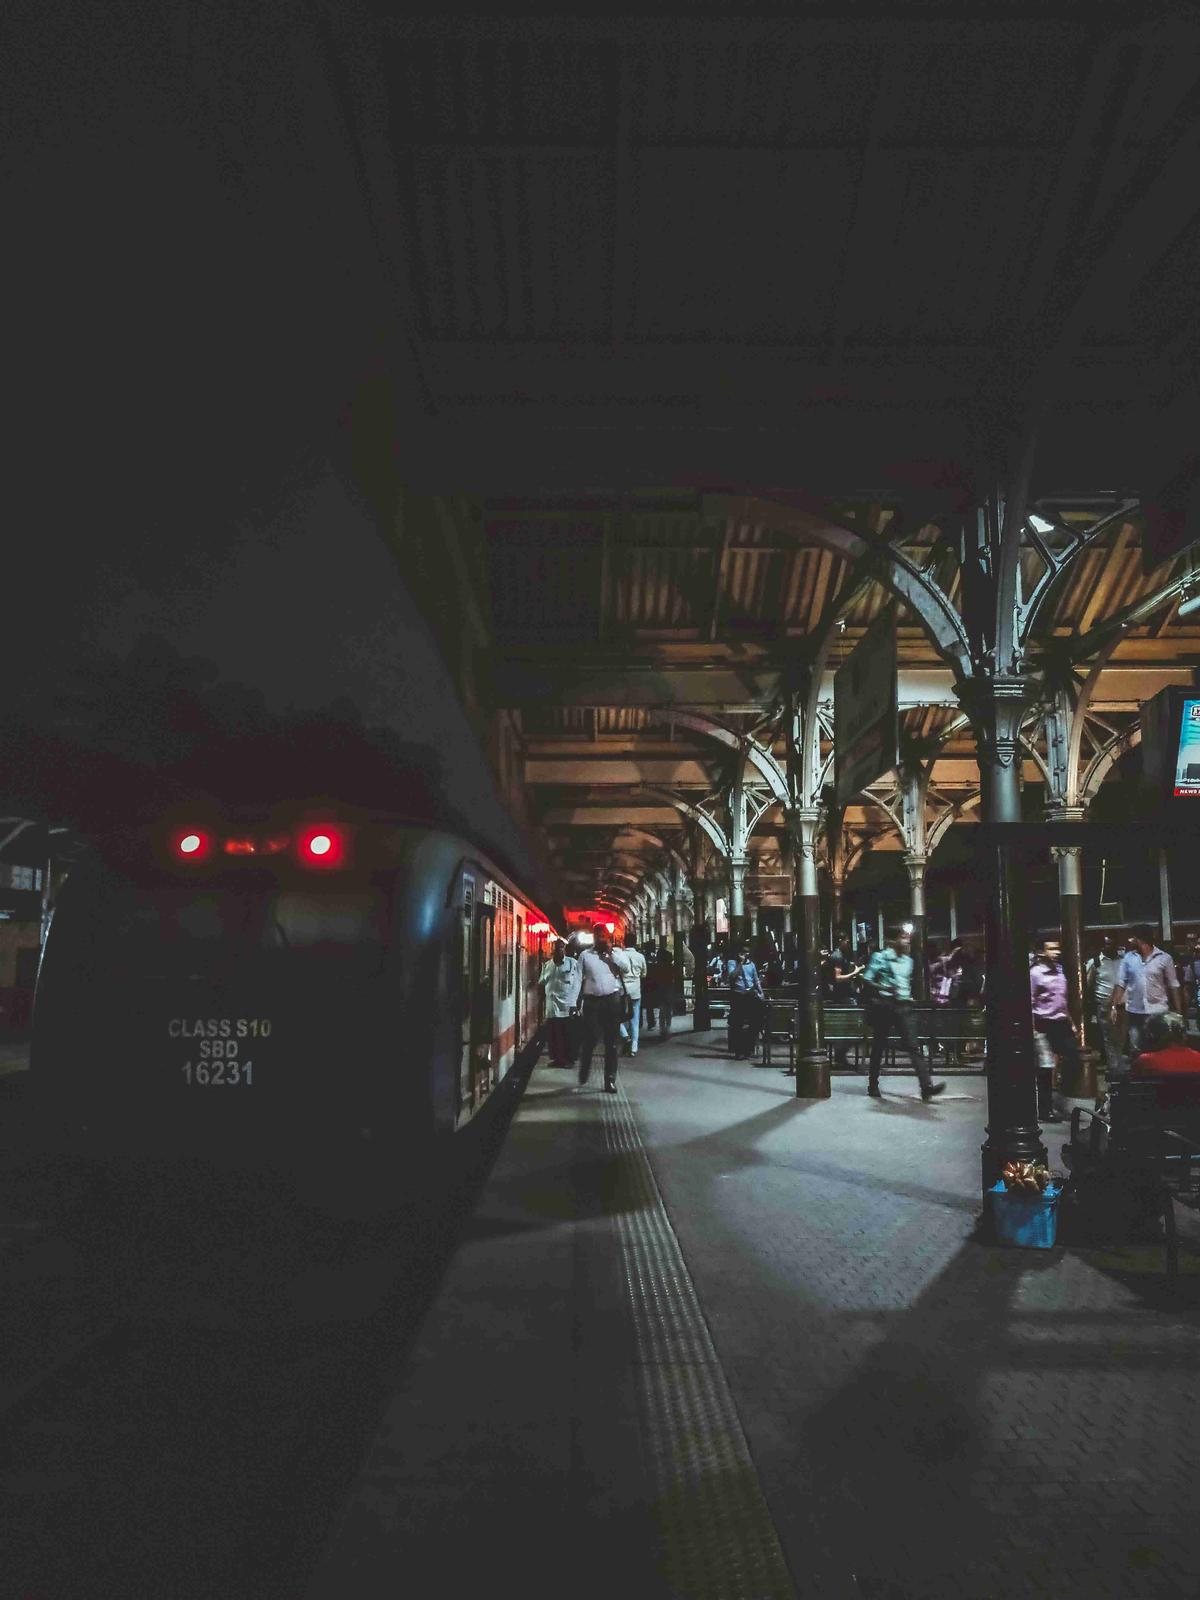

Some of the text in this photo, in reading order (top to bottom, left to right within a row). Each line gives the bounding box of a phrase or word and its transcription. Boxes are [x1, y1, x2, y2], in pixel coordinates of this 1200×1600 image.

[168, 1018, 272, 1037] CLASS S10
[200, 1040, 239, 1058] SBD
[181, 1061, 253, 1085] 16231
